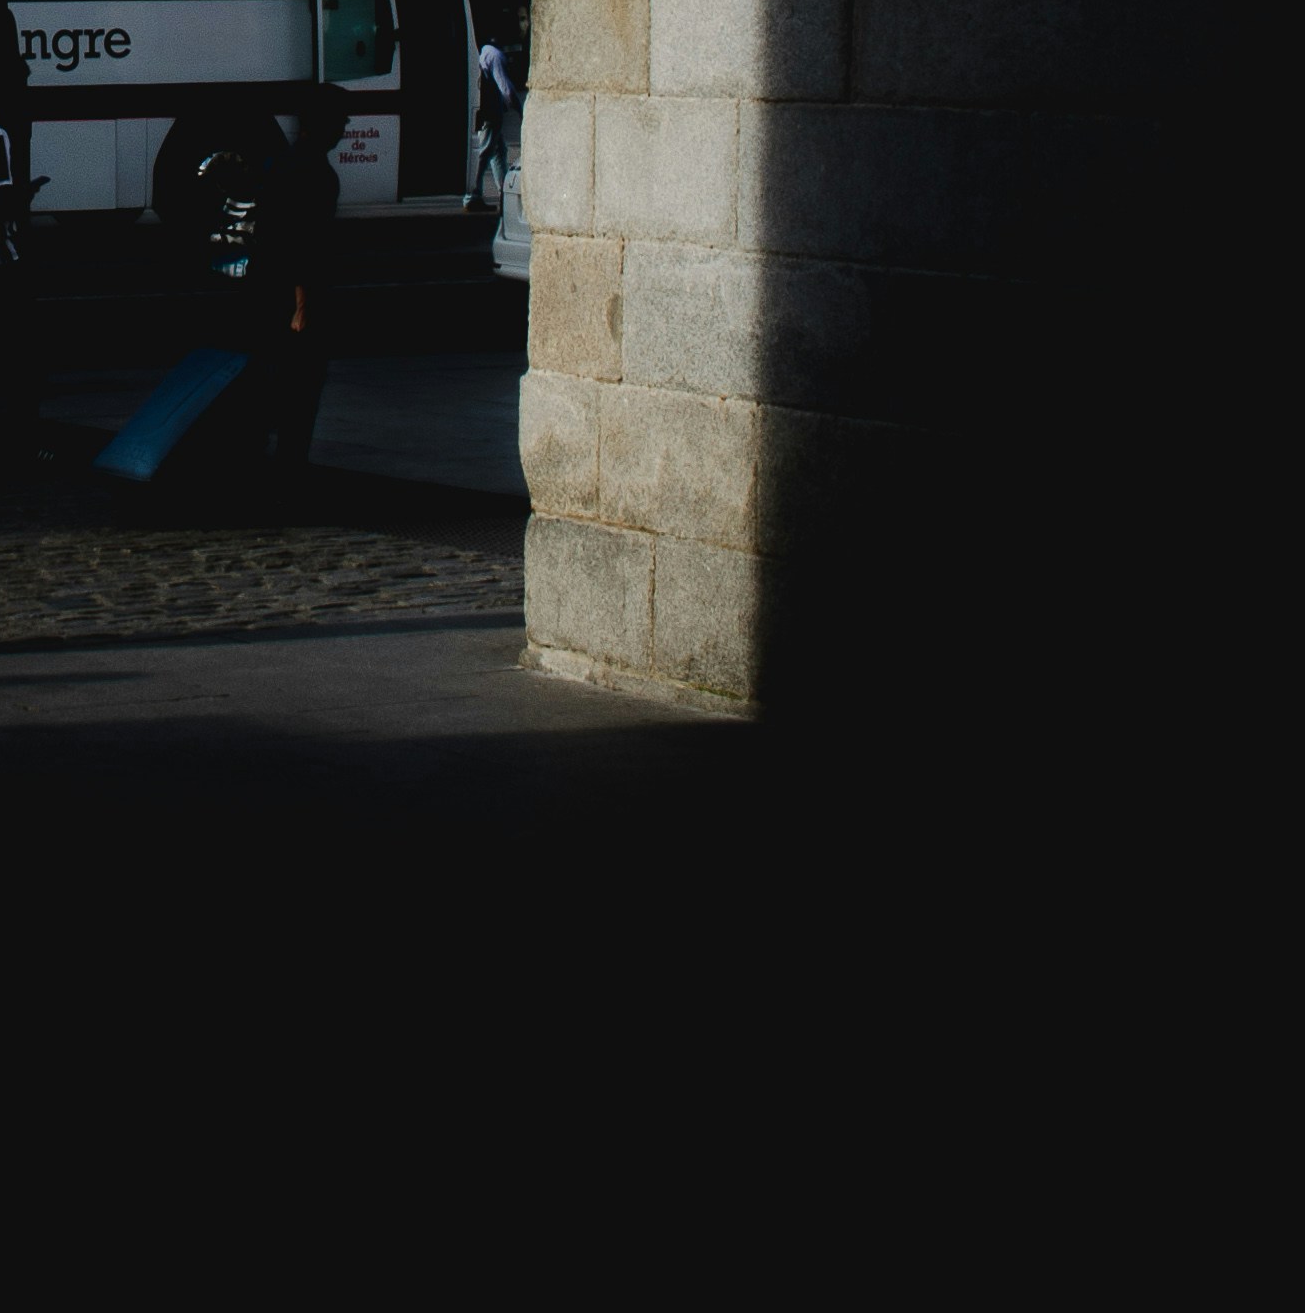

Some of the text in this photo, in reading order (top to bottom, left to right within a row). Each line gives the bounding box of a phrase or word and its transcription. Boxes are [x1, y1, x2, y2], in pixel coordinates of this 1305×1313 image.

[343, 127, 380, 139] ntrada
[351, 140, 366, 151] de
[339, 151, 378, 163] Héroes
